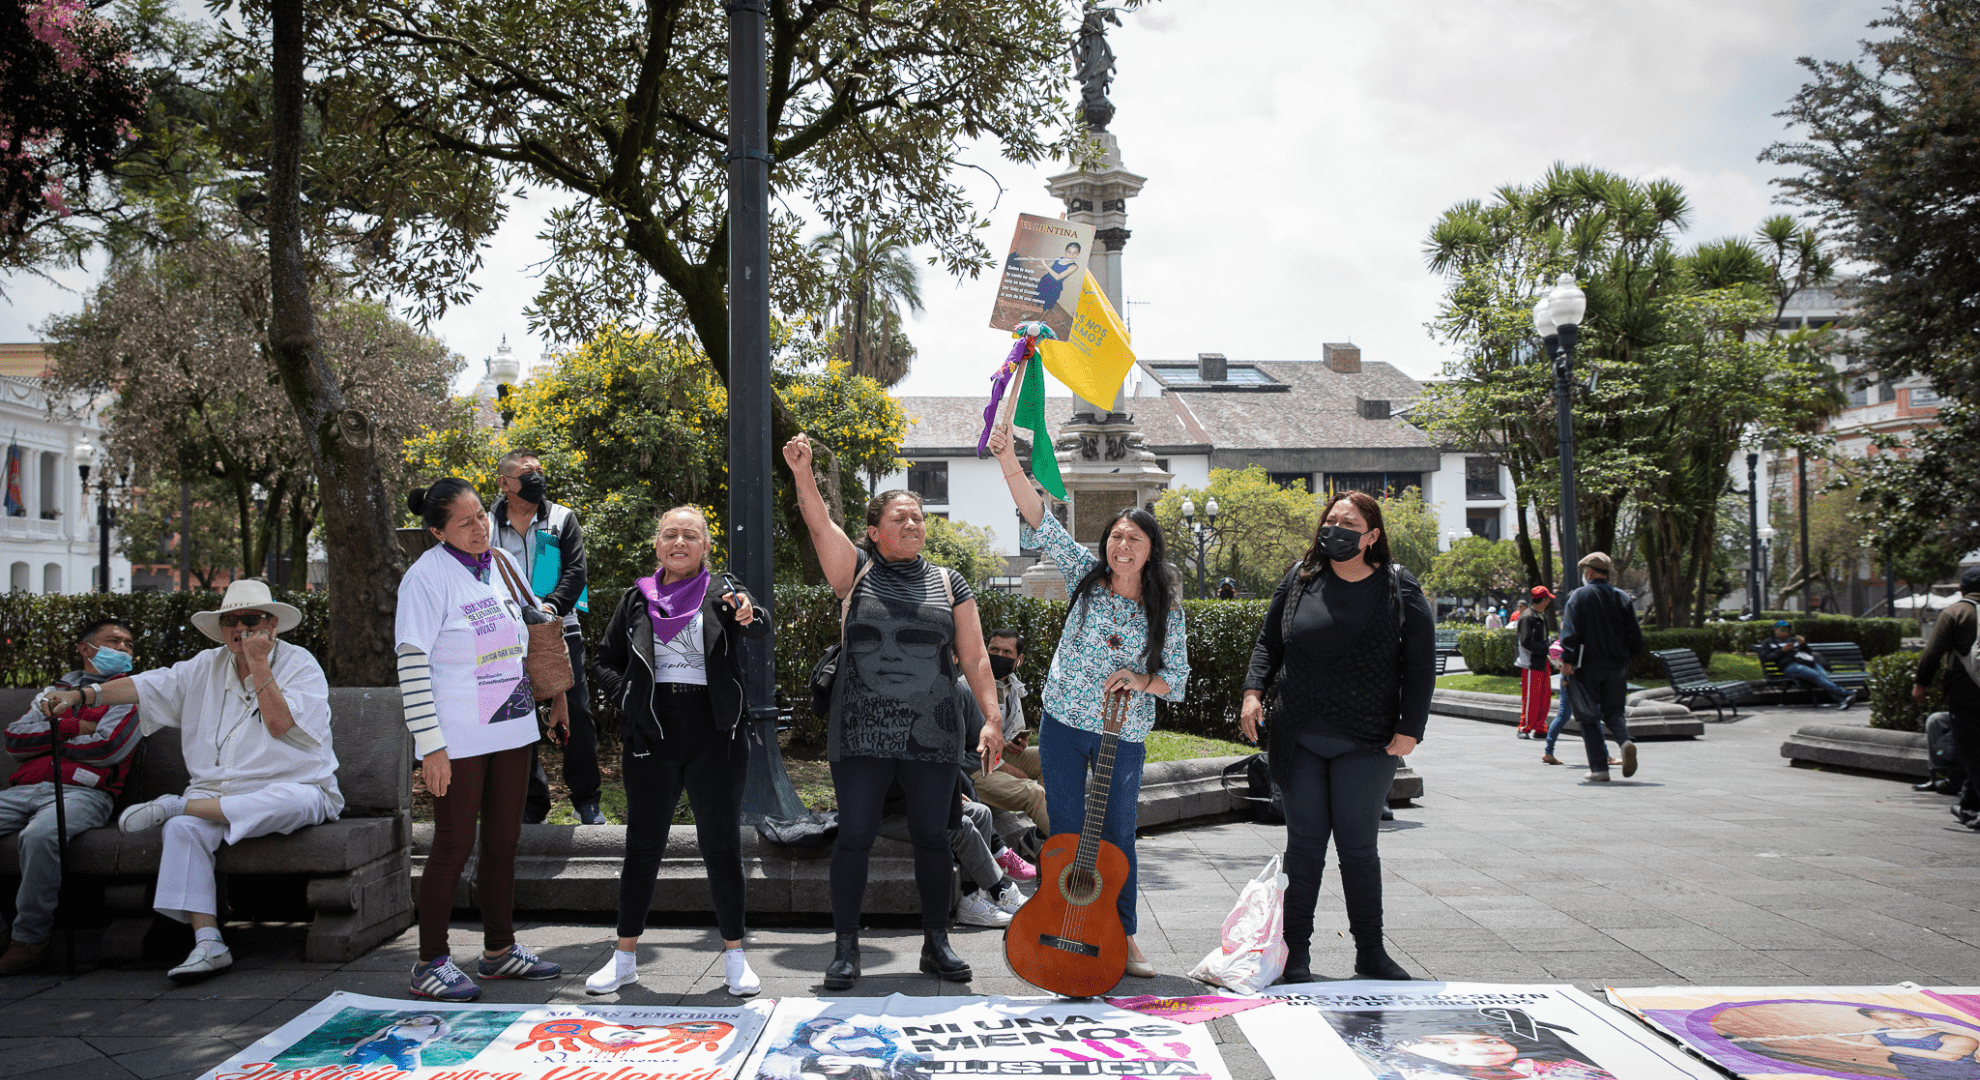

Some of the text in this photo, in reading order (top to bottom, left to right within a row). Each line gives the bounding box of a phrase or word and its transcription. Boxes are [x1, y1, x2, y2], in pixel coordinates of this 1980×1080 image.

[1021, 221, 1078, 239] VALENTINA
[1085, 319, 1109, 338] NOS
[901, 1014, 1103, 1037] NI UNA
[911, 1024, 1182, 1053] MENOS
[915, 1060, 1201, 1076] JUSTICIA
